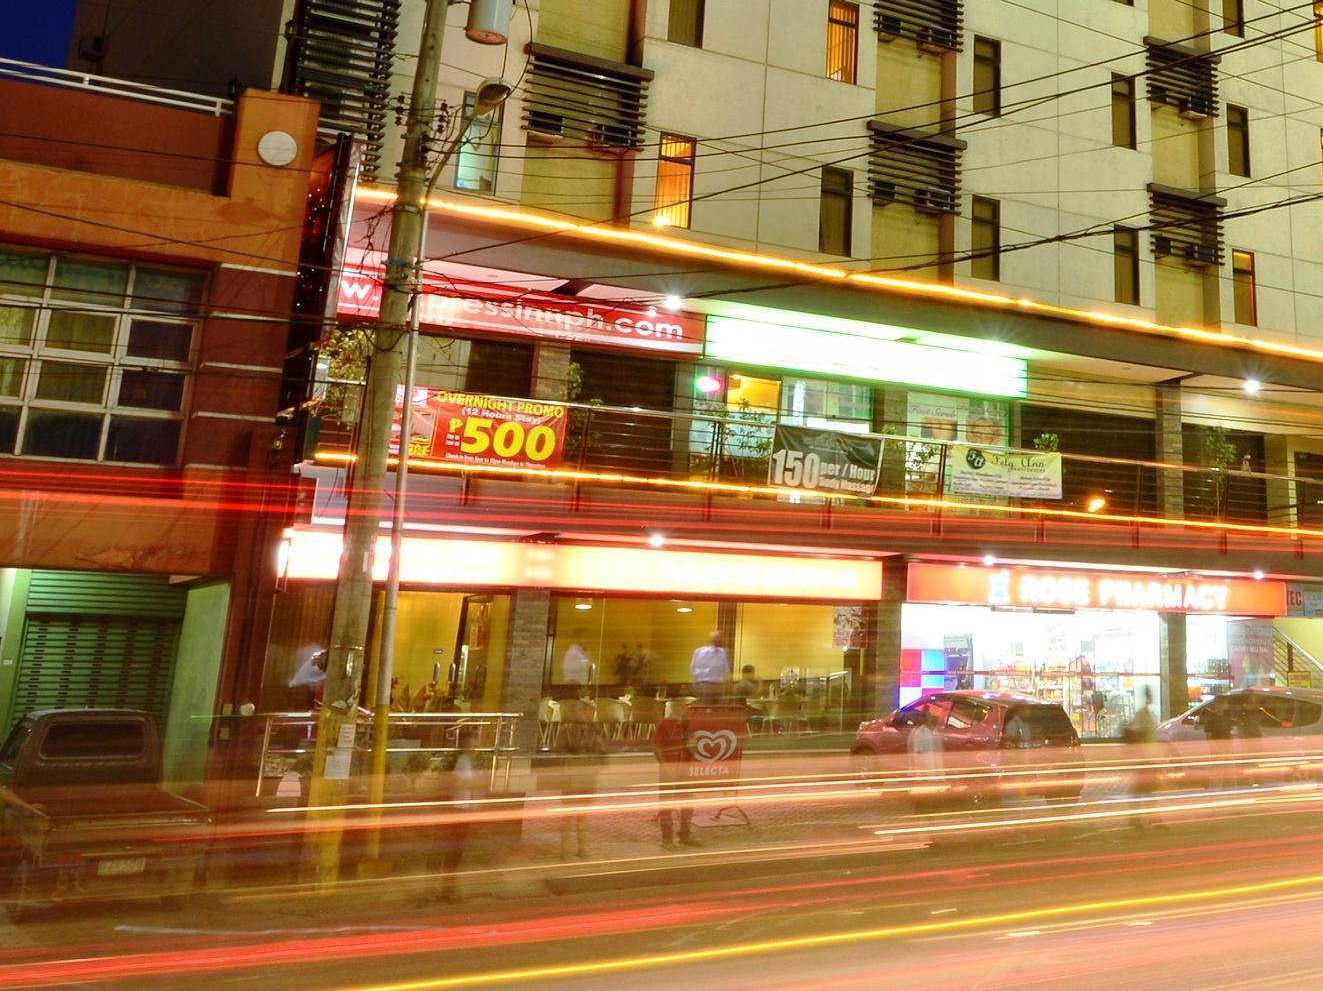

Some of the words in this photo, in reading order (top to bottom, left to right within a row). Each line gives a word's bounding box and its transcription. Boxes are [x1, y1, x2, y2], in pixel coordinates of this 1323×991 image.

[436, 390, 514, 412] OVERNIGHT
[516, 402, 565, 419] PROMO
[461, 407, 480, 417] (12
[481, 409, 513, 421] Hours
[514, 413, 543, 425] Stay)
[772, 449, 820, 489] 150
[820, 462, 841, 476] per
[841, 463, 849, 477] /
[849, 464, 876, 482] Hour
[1019, 573, 1090, 605] ROSE
[1098, 577, 1230, 610] PHARMACY
[688, 765, 729, 777] SELECTA
